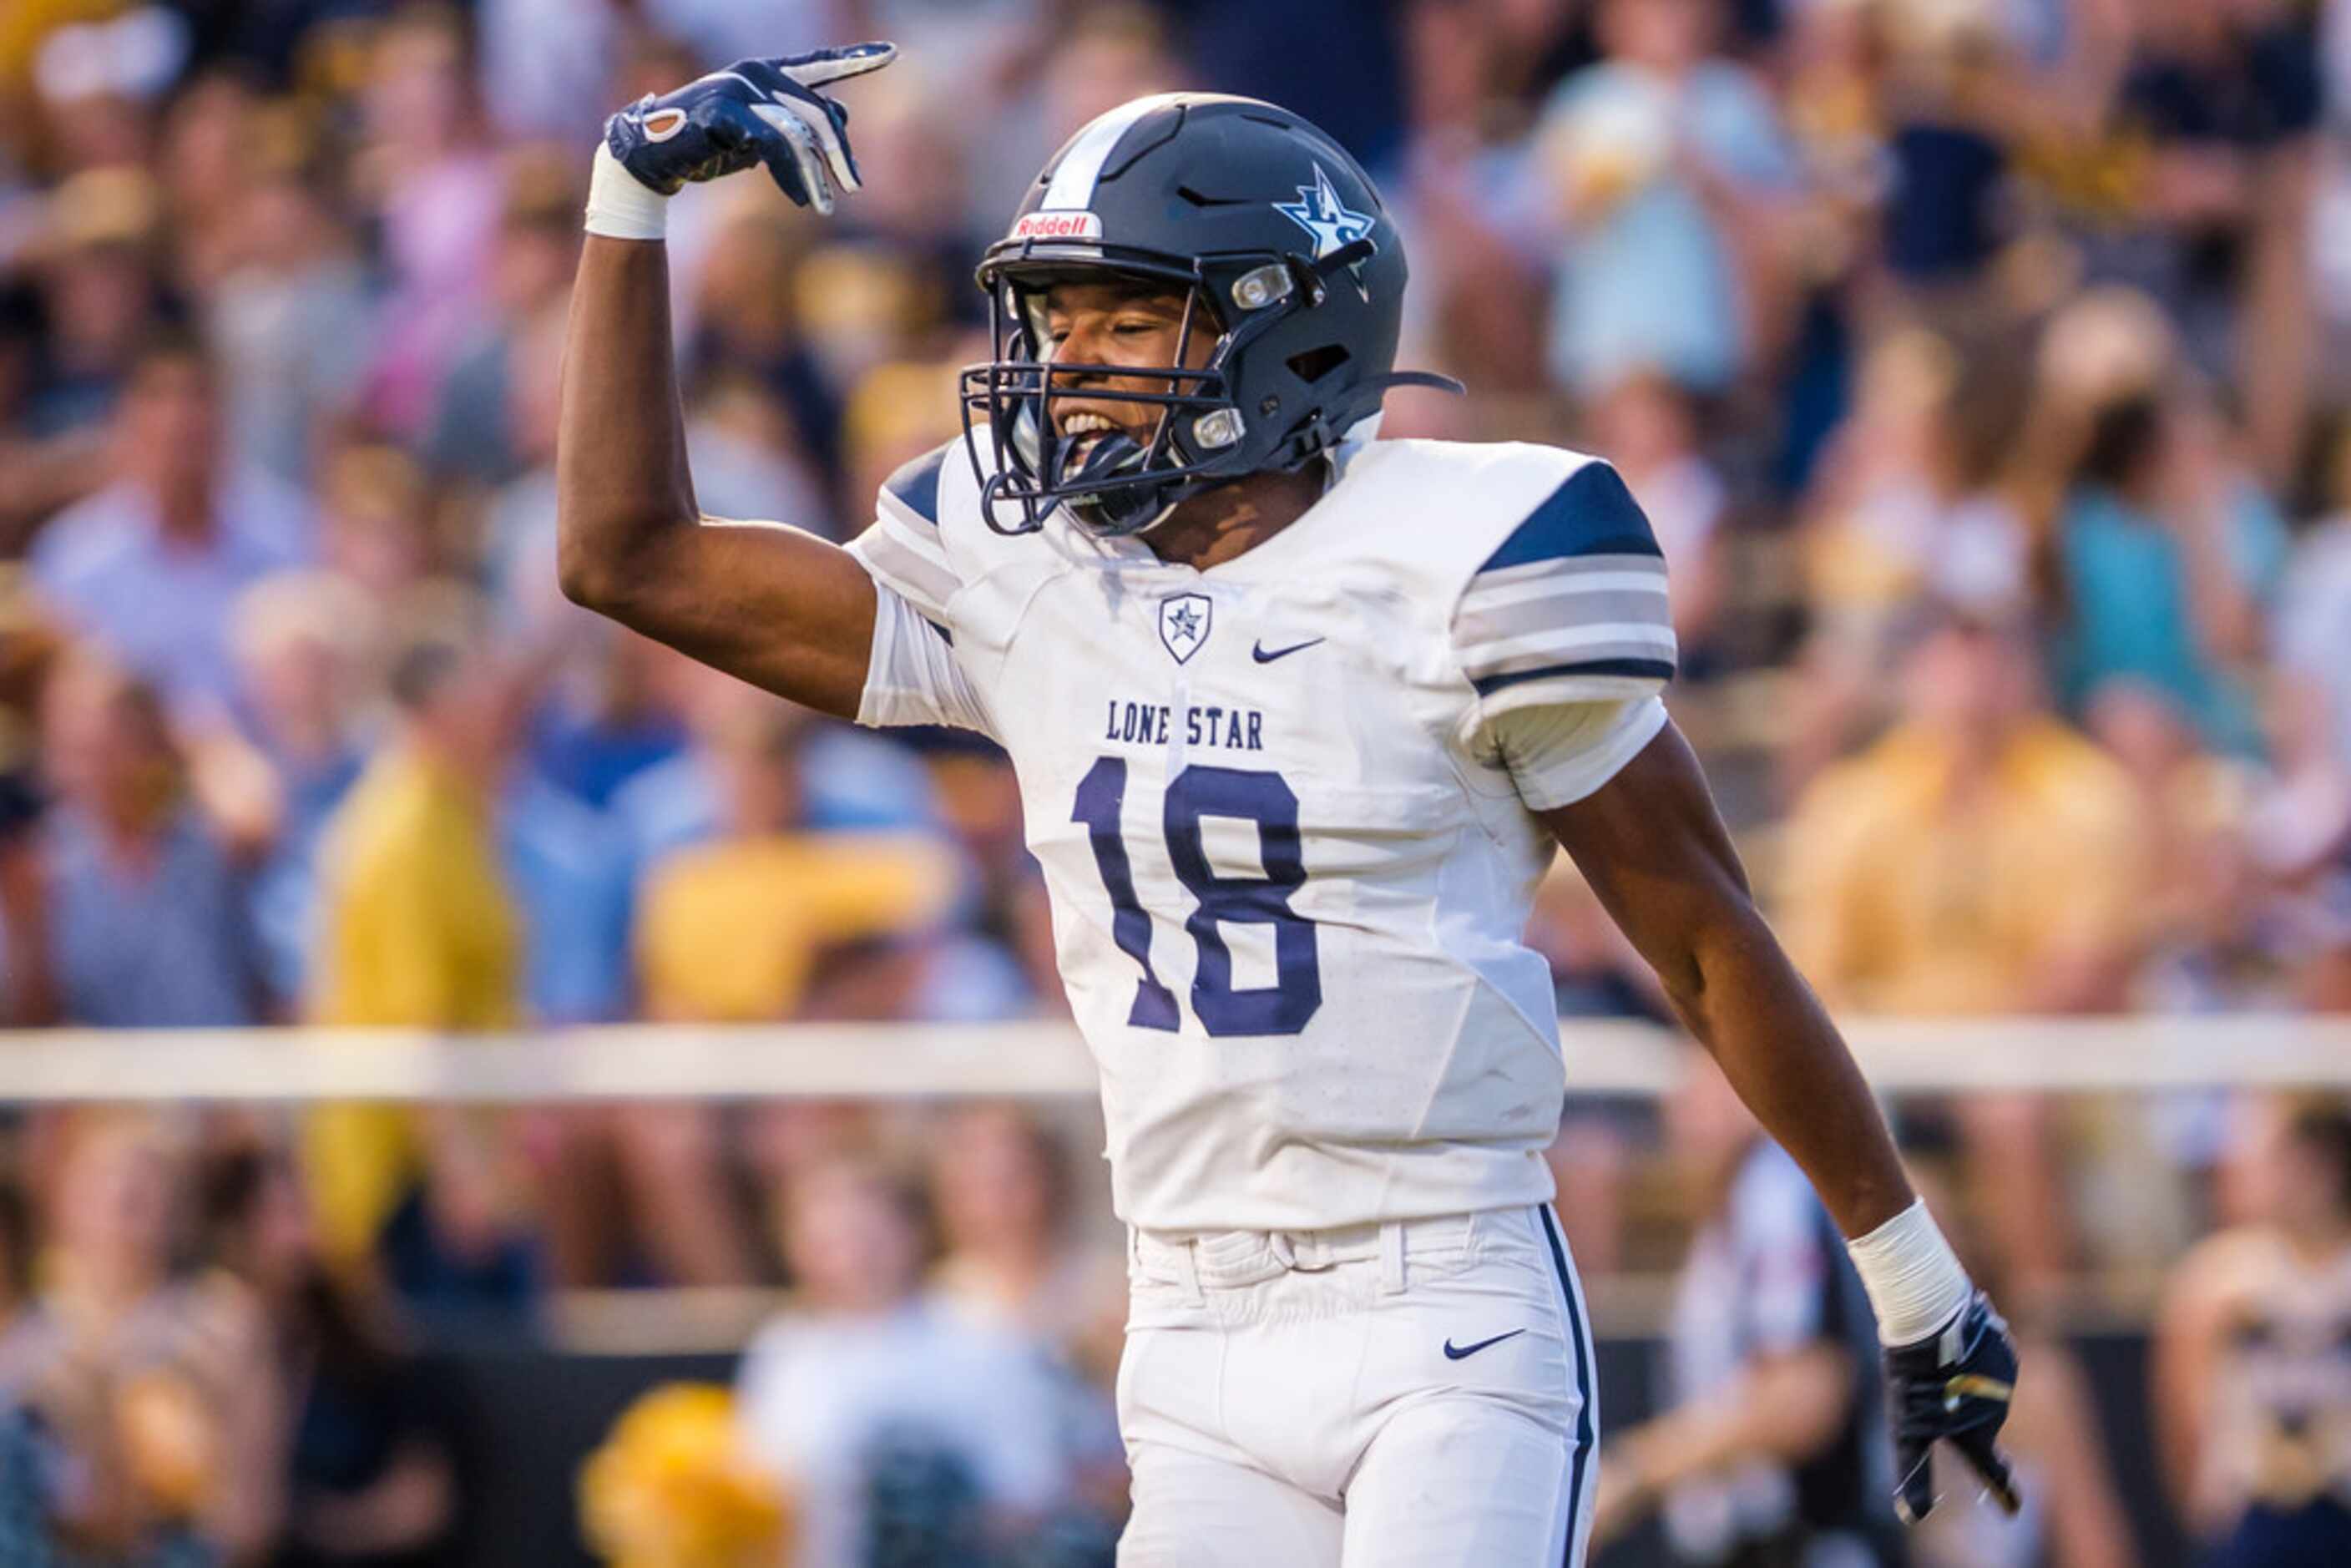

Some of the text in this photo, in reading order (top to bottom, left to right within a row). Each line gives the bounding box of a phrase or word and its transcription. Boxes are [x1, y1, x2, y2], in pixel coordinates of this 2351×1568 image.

[1018, 215, 1088, 235] Riddell
[1106, 700, 1263, 751] LONE STAR
[1070, 756, 1323, 1038] 18
